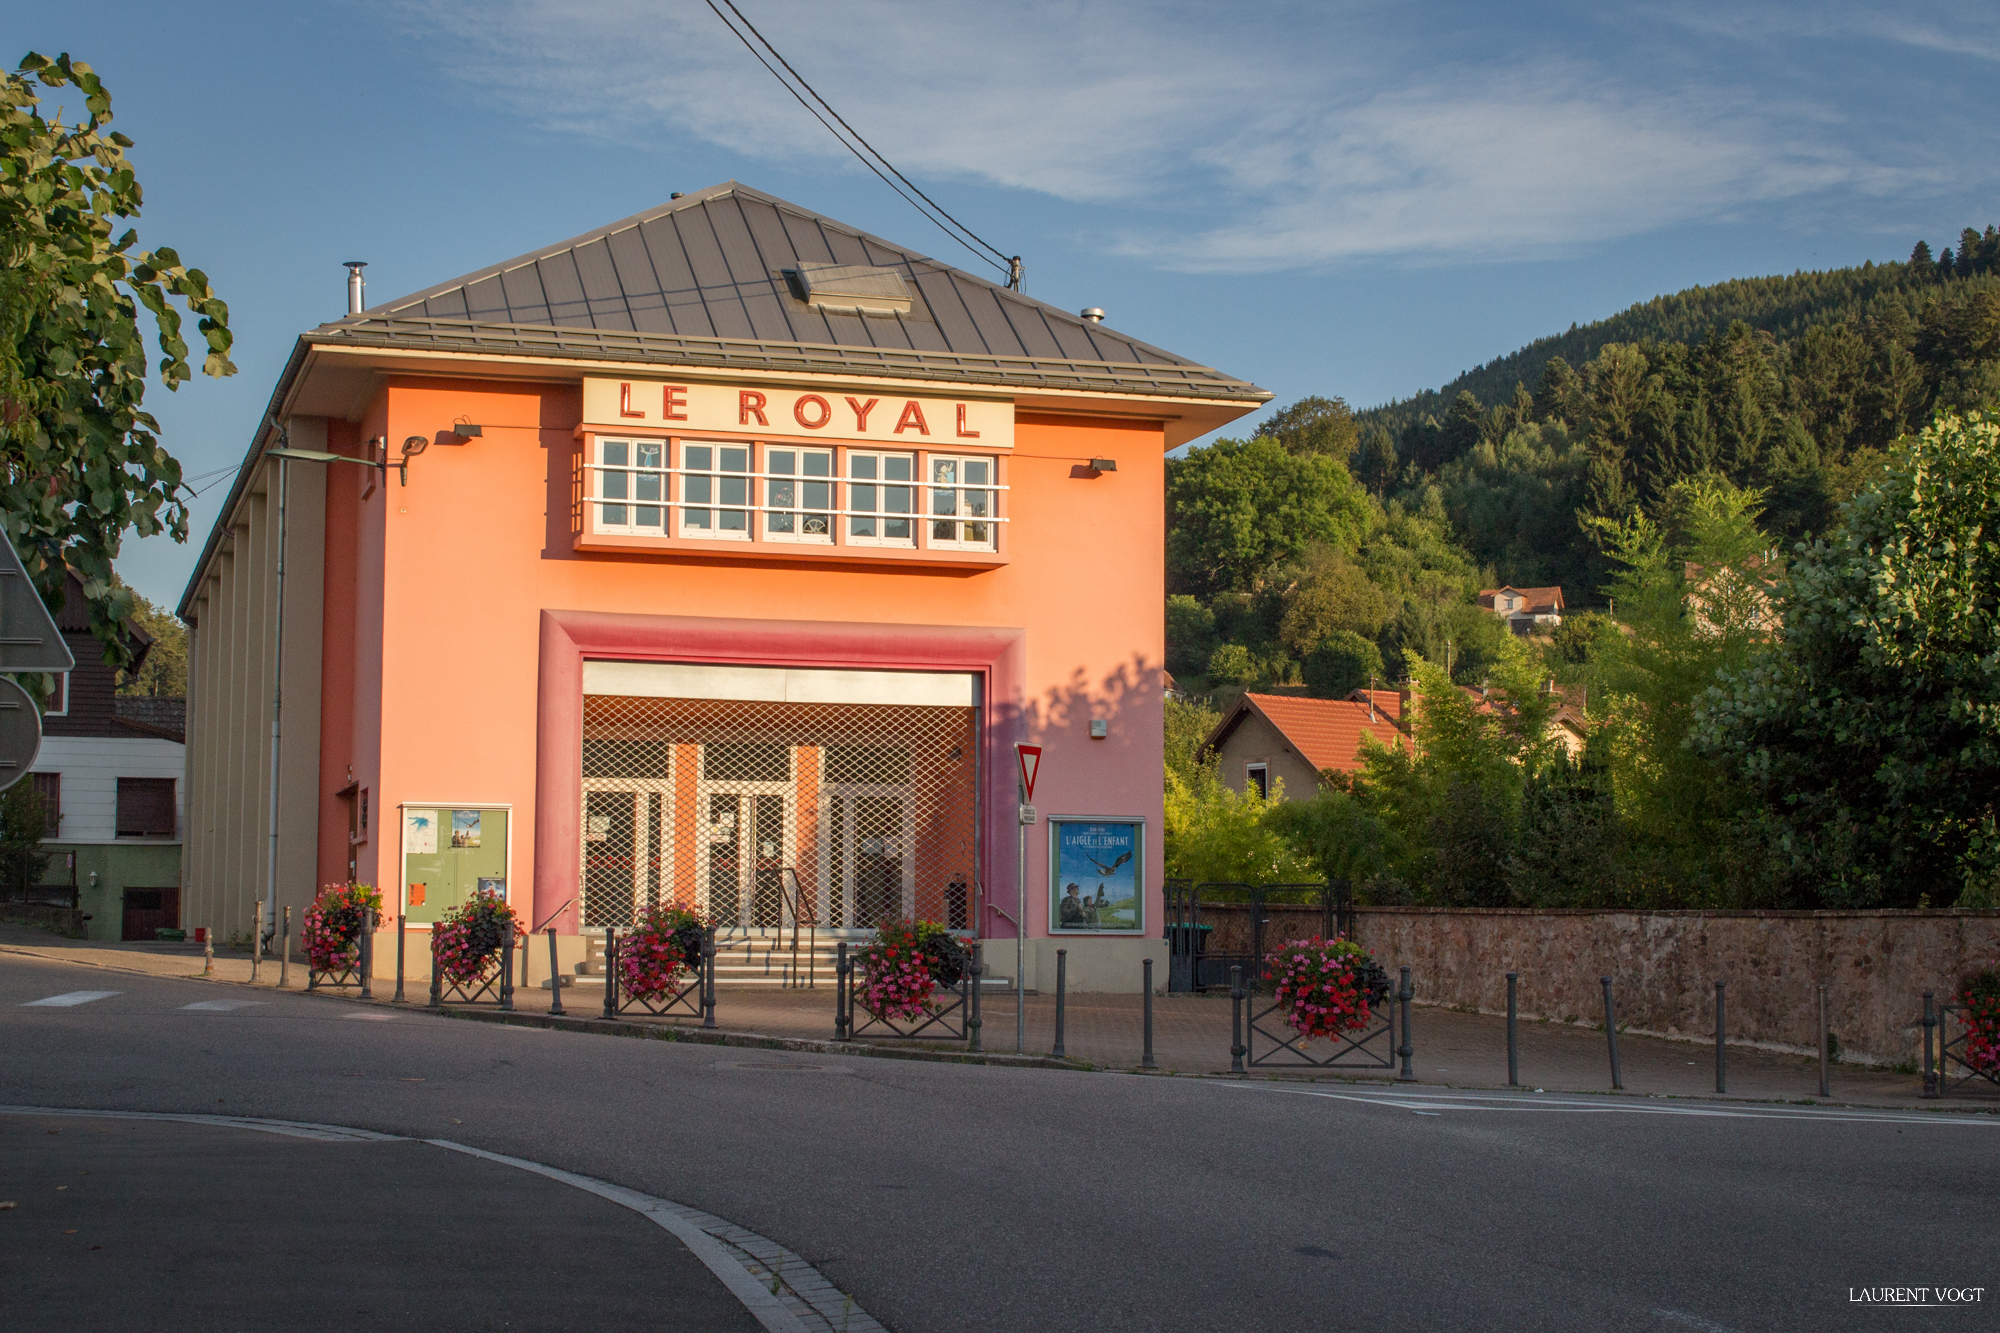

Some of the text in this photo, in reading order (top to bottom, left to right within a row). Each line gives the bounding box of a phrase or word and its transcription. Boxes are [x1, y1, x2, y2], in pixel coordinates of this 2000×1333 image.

[620, 382, 981, 439] LE ROYAL
[1066, 835, 1091, 846] L'AIGLE
[1098, 836, 1128, 846] L'ENFANT
